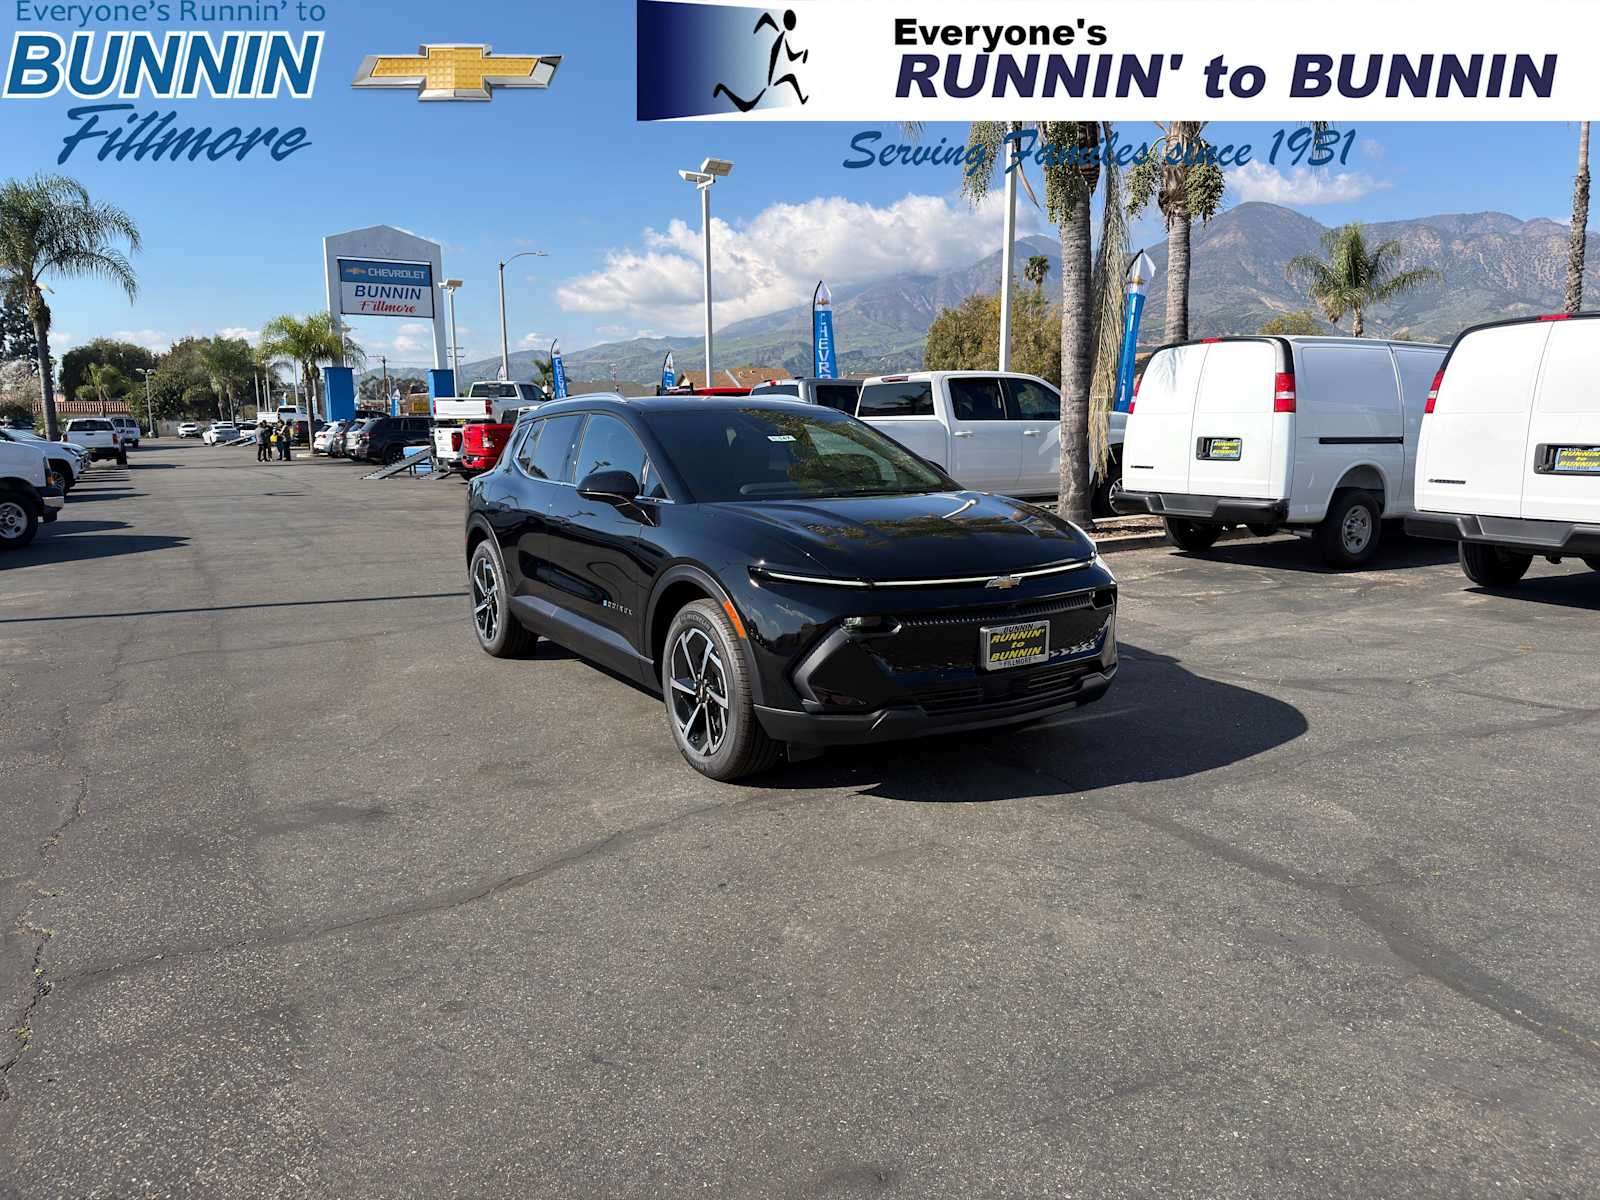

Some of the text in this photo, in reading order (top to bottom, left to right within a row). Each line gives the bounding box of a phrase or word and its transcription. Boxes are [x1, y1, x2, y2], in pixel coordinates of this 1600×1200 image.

[367, 267, 425, 279] CHEVROLET
[355, 285, 422, 300] BUNNIN
[358, 299, 417, 314] Fillmore
[990, 646, 1042, 662] BUNNIN
